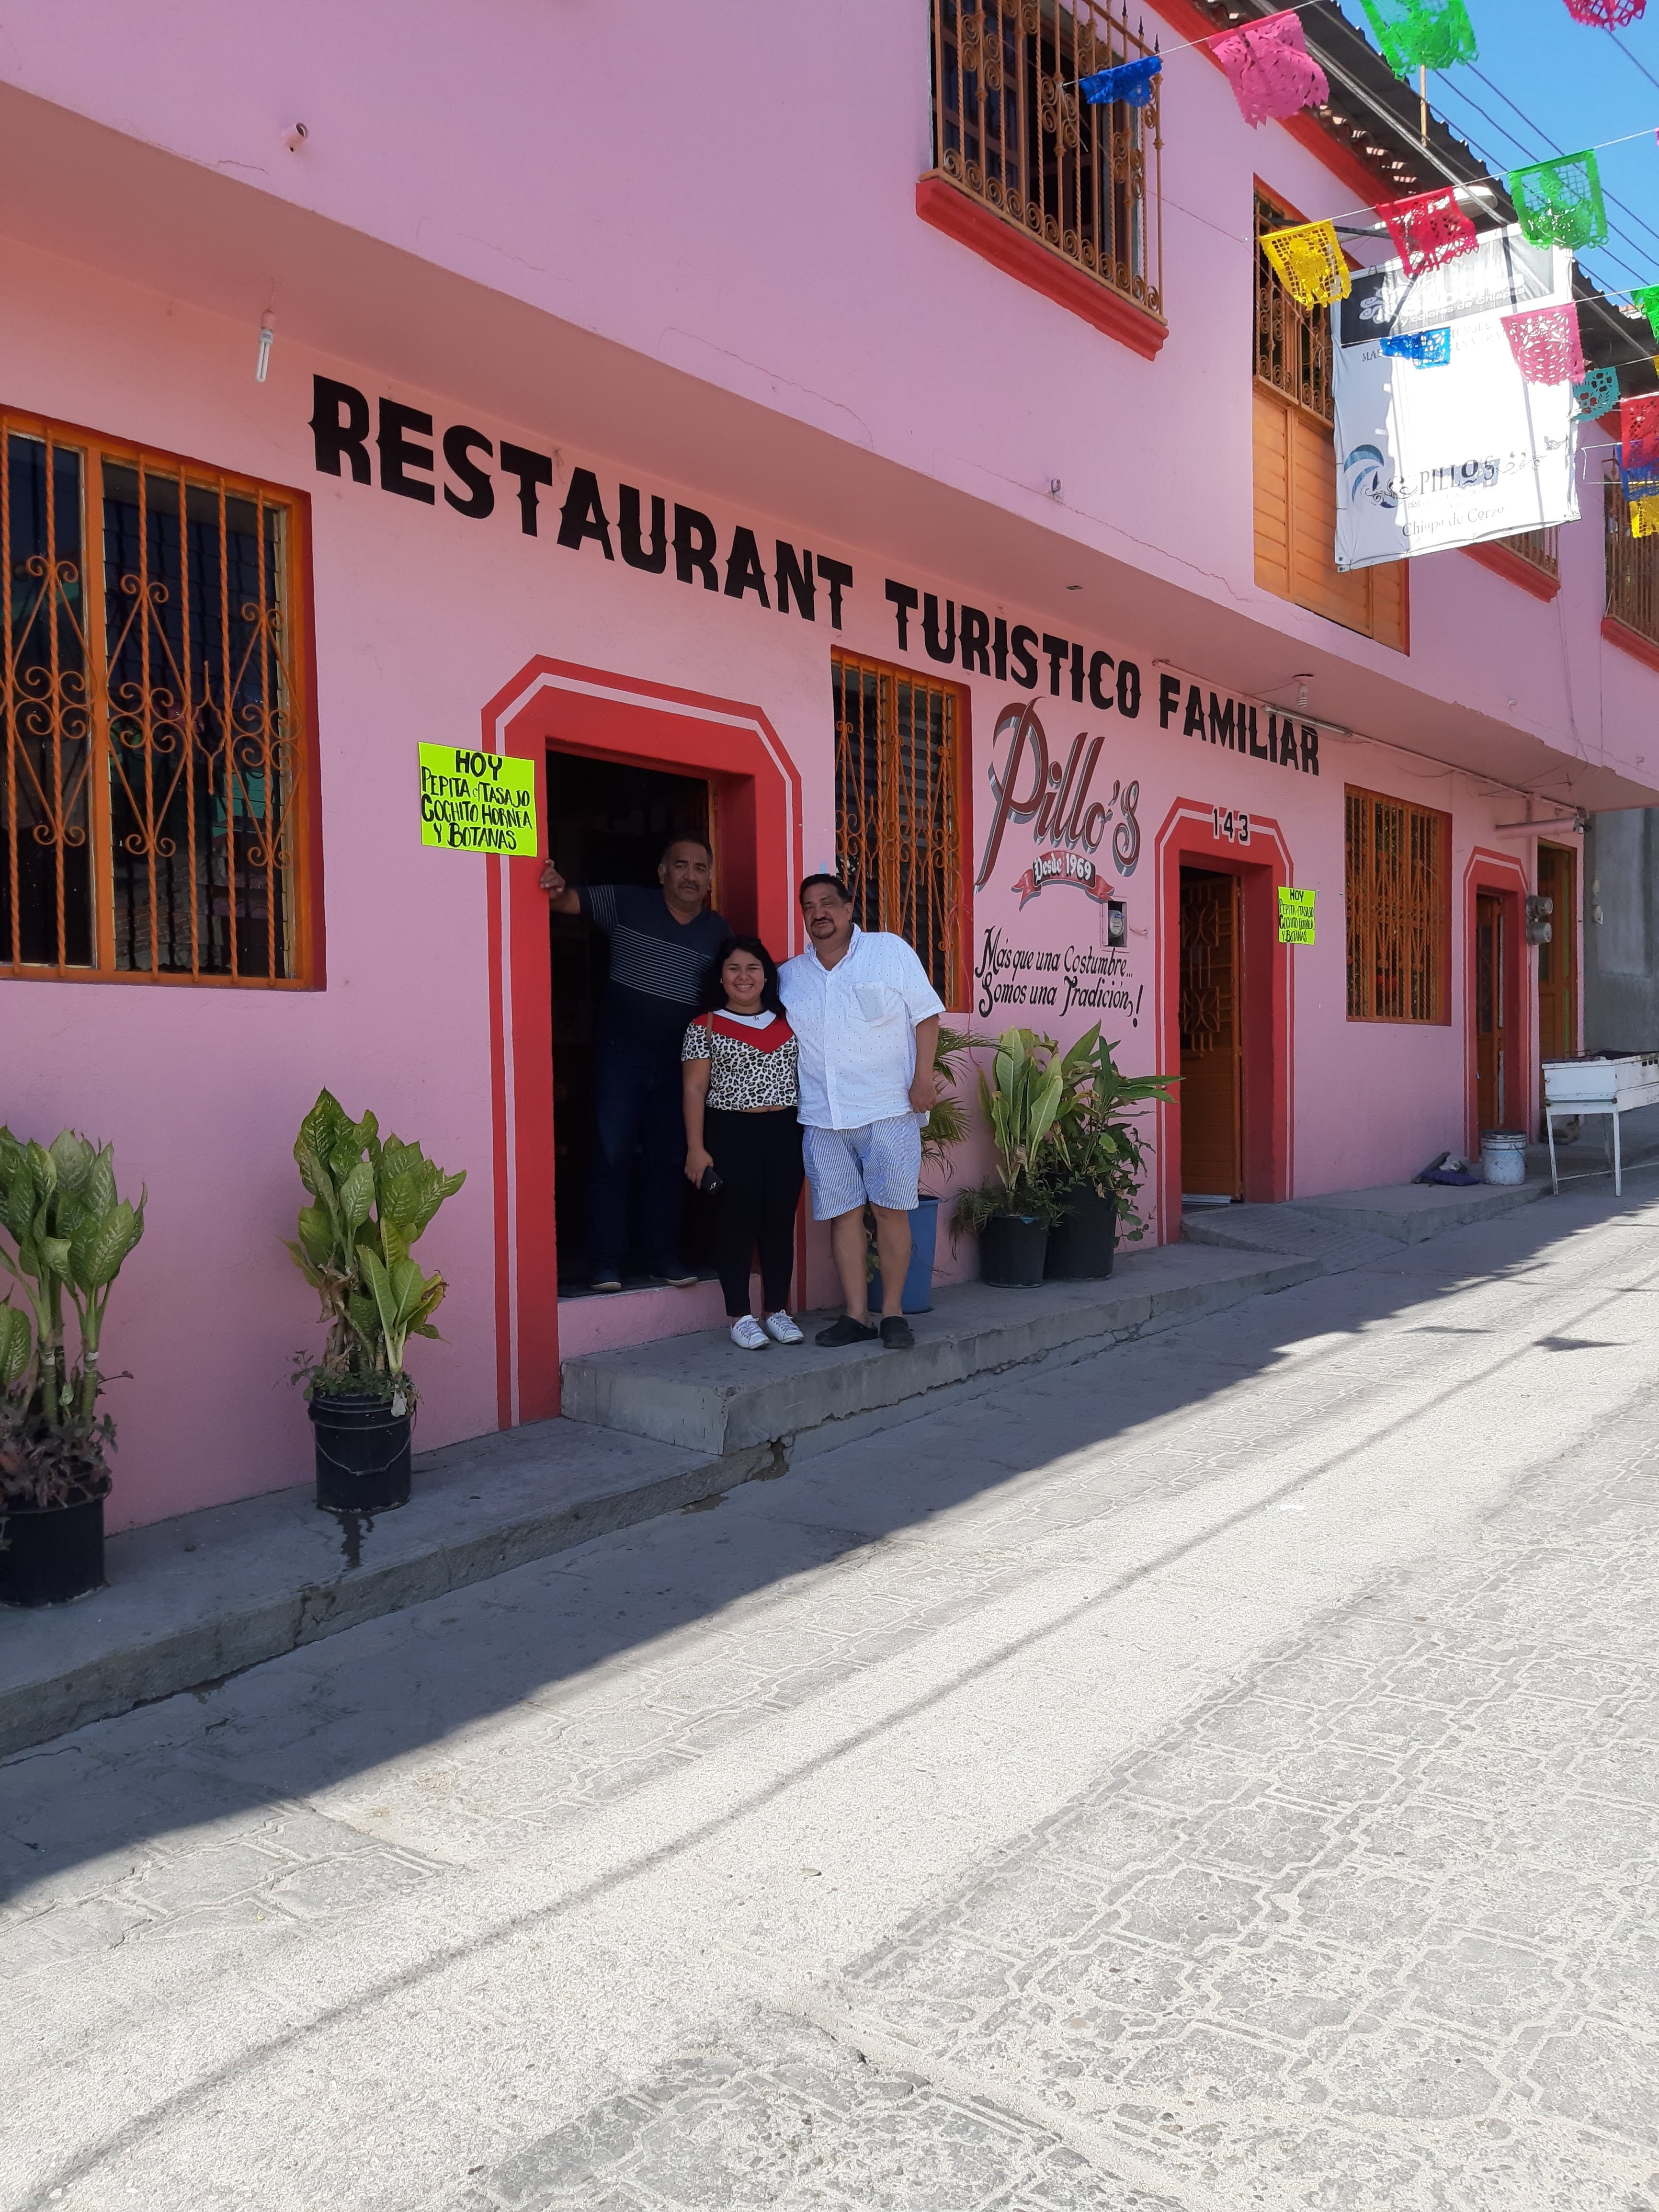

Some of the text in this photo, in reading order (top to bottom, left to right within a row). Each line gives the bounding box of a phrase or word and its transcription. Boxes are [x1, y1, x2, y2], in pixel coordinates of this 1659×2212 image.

[1400, 287, 1525, 328] y colores de Chiapas
[308, 374, 1319, 776] RESTAURANT TURISTICO FAMILIAR
[455, 750, 502, 781] HOY
[421, 766, 471, 798] PEPITA
[421, 794, 478, 822] COCHITO
[433, 822, 517, 850] Y BOTANAS
[1214, 809, 1248, 842] 143
[1034, 852, 1091, 885] Desde 1969
[1279, 898, 1296, 915] PEPITA
[1290, 889, 1304, 903] HOY
[1279, 914, 1298, 928] COCHITO
[1282, 930, 1307, 943] Y BOTANAS
[1012, 950, 1034, 982] que
[1035, 951, 1060, 972] una
[979, 972, 1027, 1018] Somos
[1030, 986, 1057, 1006] una
